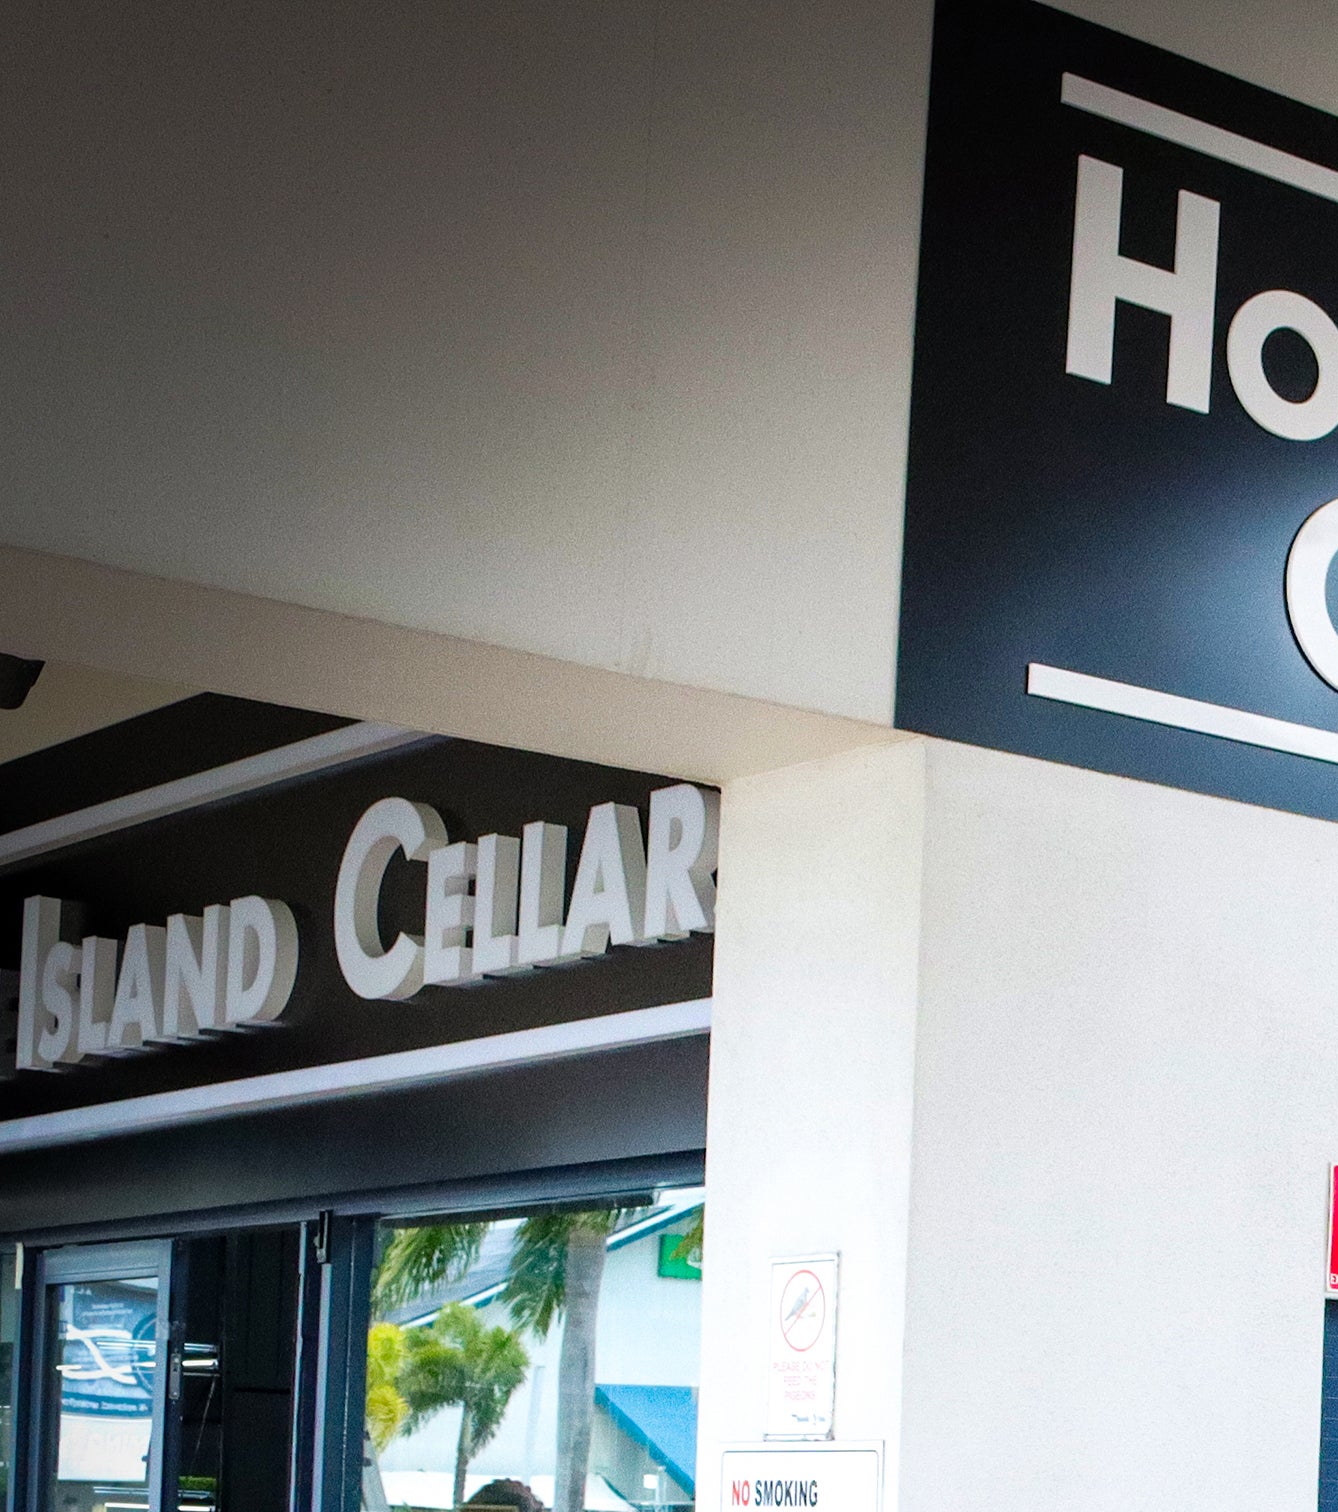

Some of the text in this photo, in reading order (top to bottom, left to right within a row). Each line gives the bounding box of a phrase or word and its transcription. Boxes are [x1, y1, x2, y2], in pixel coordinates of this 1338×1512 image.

[16, 783, 718, 1071] ISLAND CELLAR
[731, 1480, 818, 1507] NO SMOKING
